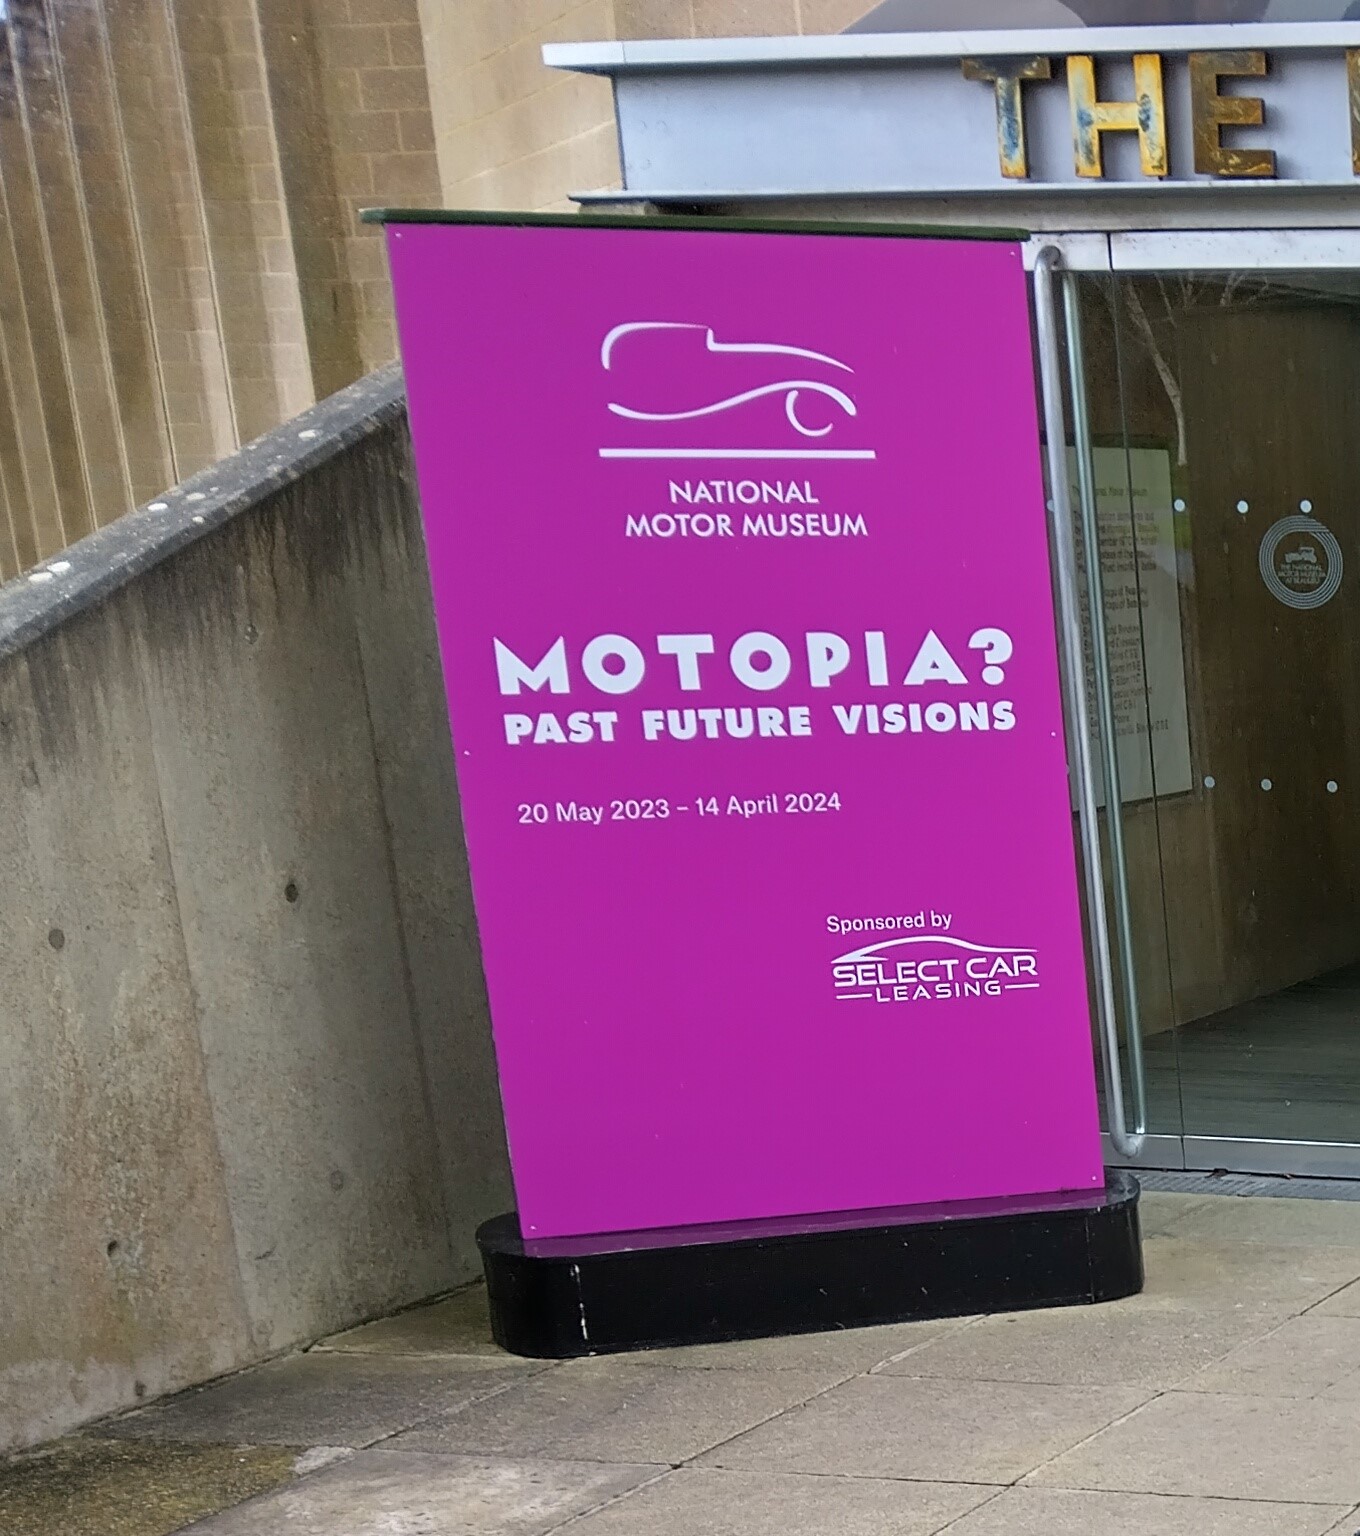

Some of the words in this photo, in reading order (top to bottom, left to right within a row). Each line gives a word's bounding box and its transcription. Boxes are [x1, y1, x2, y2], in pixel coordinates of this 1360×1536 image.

[962, 47, 1276, 181] THE
[668, 480, 818, 505] NATIONAL
[625, 512, 734, 537] MOTOR
[742, 510, 869, 537] MUSEUM
[492, 628, 1015, 696] MOTOPIA?
[502, 710, 619, 746] PAST
[642, 705, 813, 742] FUTURE
[833, 700, 1017, 735] VISIONS
[517, 803, 549, 824] 20
[554, 800, 605, 828] May
[610, 798, 672, 822] 2023
[694, 797, 721, 818] 14
[725, 794, 779, 820] April
[784, 791, 842, 814] 2024
[826, 914, 926, 936] Sponsored
[931, 911, 954, 934] by
[832, 959, 959, 986] SELECT
[964, 953, 1039, 981] CAR
[876, 981, 1003, 1003] LEASING
